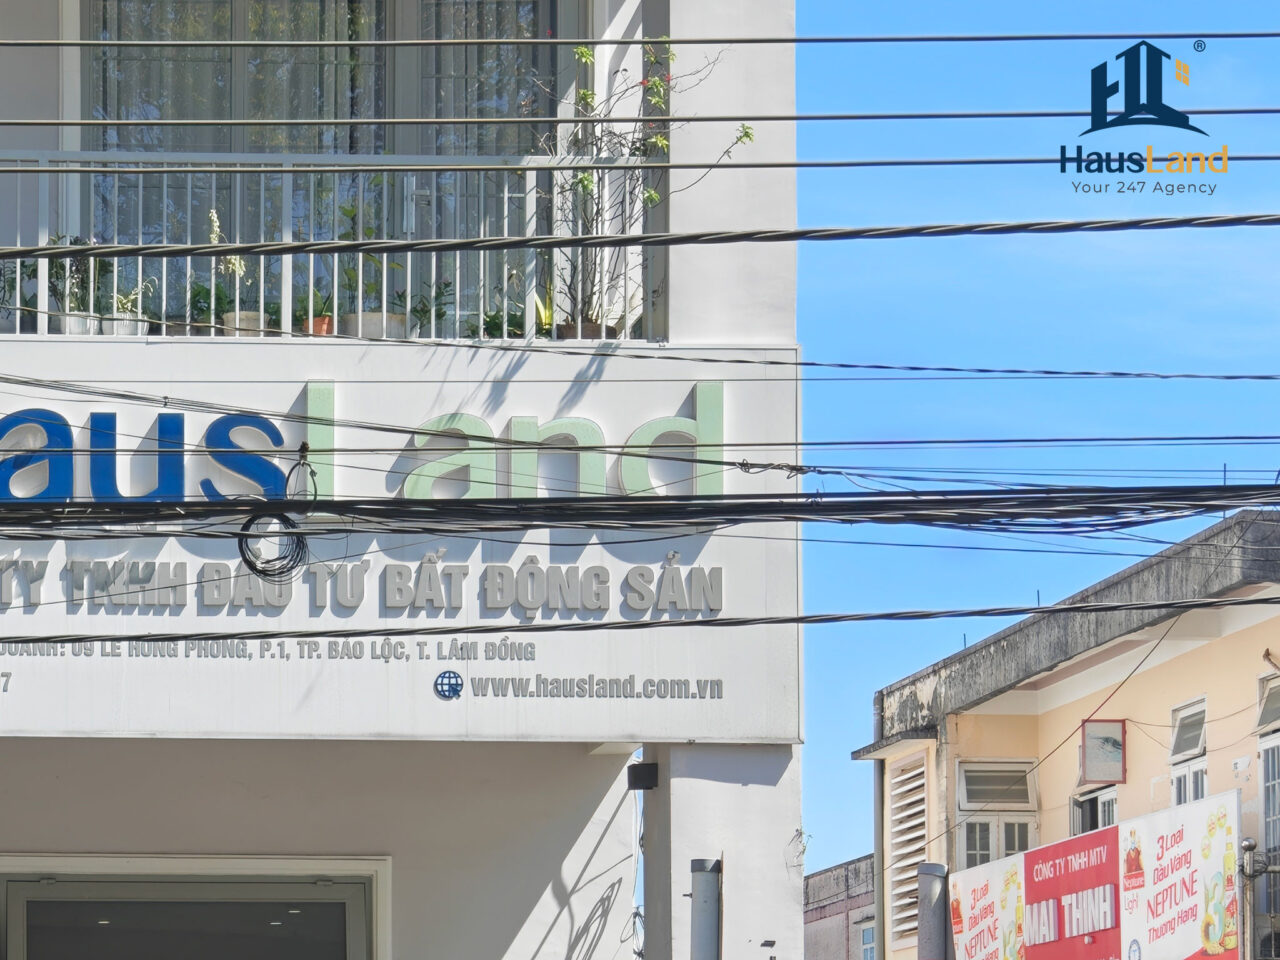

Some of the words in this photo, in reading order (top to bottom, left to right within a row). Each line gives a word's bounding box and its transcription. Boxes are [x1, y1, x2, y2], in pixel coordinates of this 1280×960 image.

[67, 561, 187, 606] TNHH
[310, 559, 370, 608] TƯ
[386, 548, 469, 608] BẤT
[485, 555, 610, 618] ĐỘNG
[626, 551, 723, 611] SẢN
[297, 640, 321, 660] TP.
[371, 637, 410, 663] LỘC,
[417, 641, 430, 660] T.
[437, 638, 478, 661] LÂM
[485, 636, 536, 661] ĐỒNG
[470, 674, 723, 699] www.hausland.com.vn
[1033, 860, 1054, 882] CÔNG
[1055, 857, 1065, 876] TY
[1067, 853, 1088, 873] TNHH
[1089, 845, 1107, 866] MTV
[1156, 835, 1165, 862] 3
[1146, 868, 1198, 923] NEPTUNE
[1025, 899, 1057, 946] MAI
[1062, 884, 1115, 944] THỊNH
